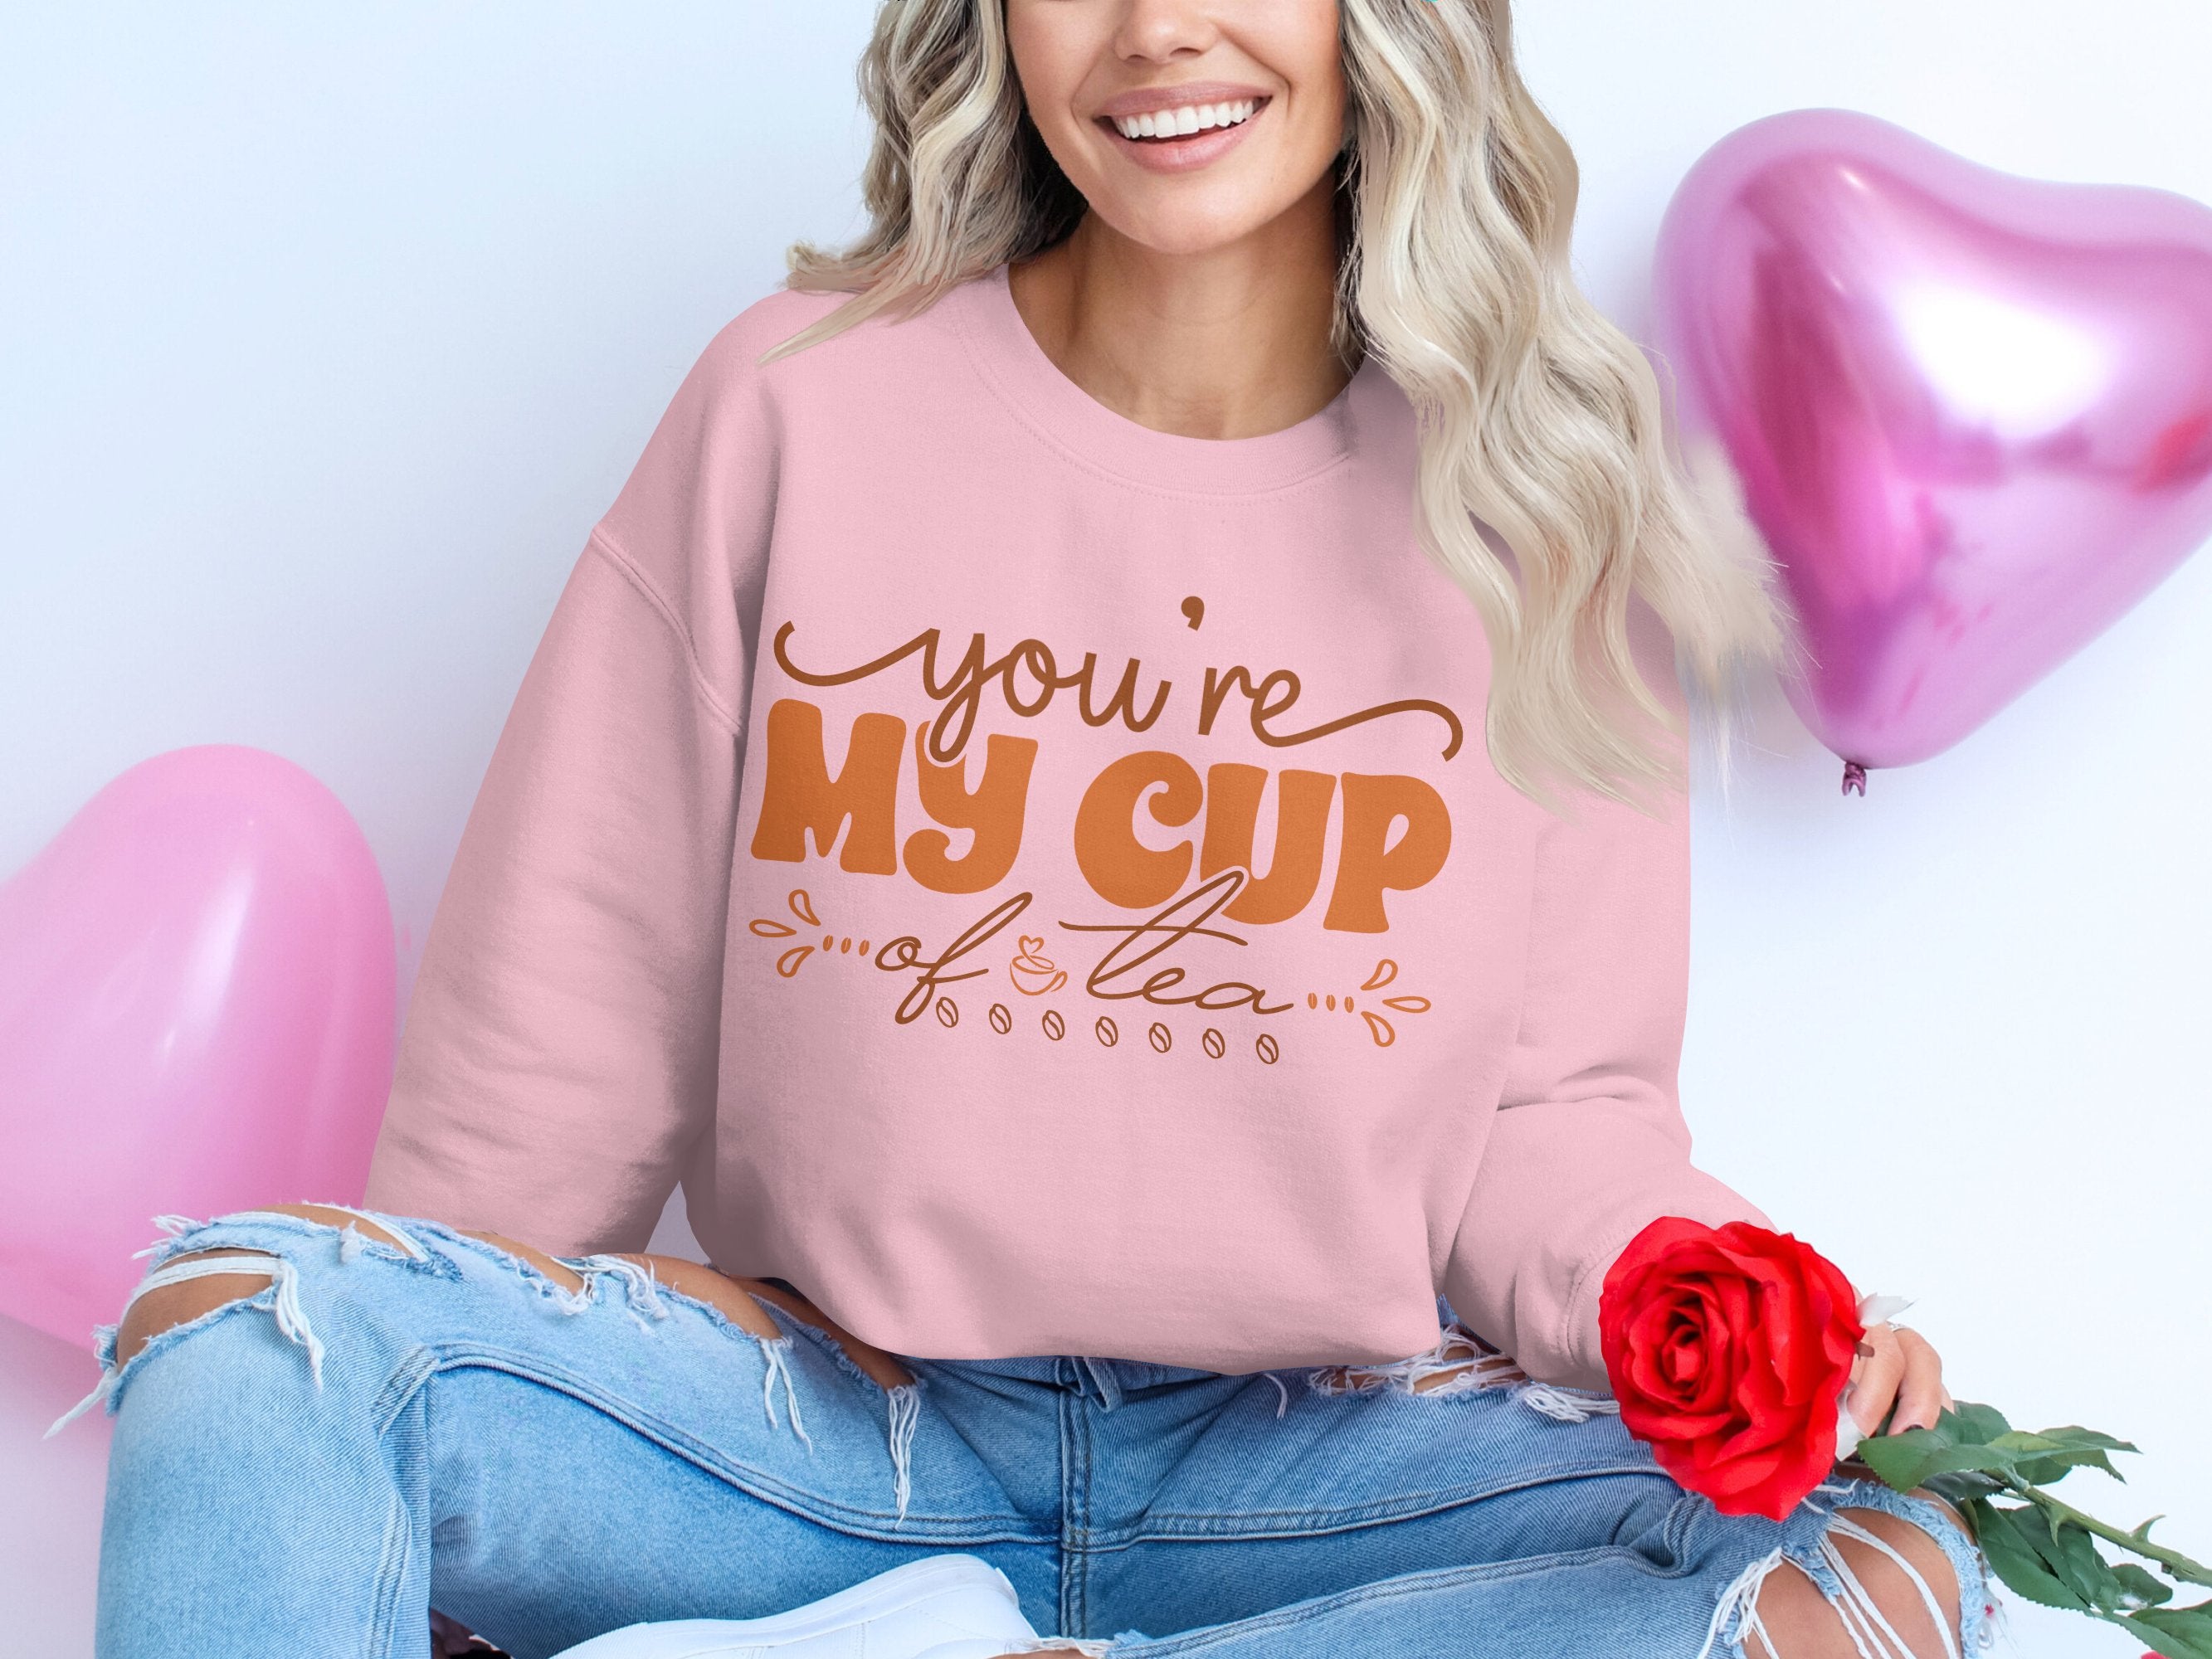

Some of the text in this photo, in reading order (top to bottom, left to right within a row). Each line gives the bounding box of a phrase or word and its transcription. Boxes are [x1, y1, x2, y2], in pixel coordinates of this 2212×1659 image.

[773, 596, 1464, 762] you're
[750, 698, 1453, 934] MY CUP
[875, 870, 1294, 1025] of tea
